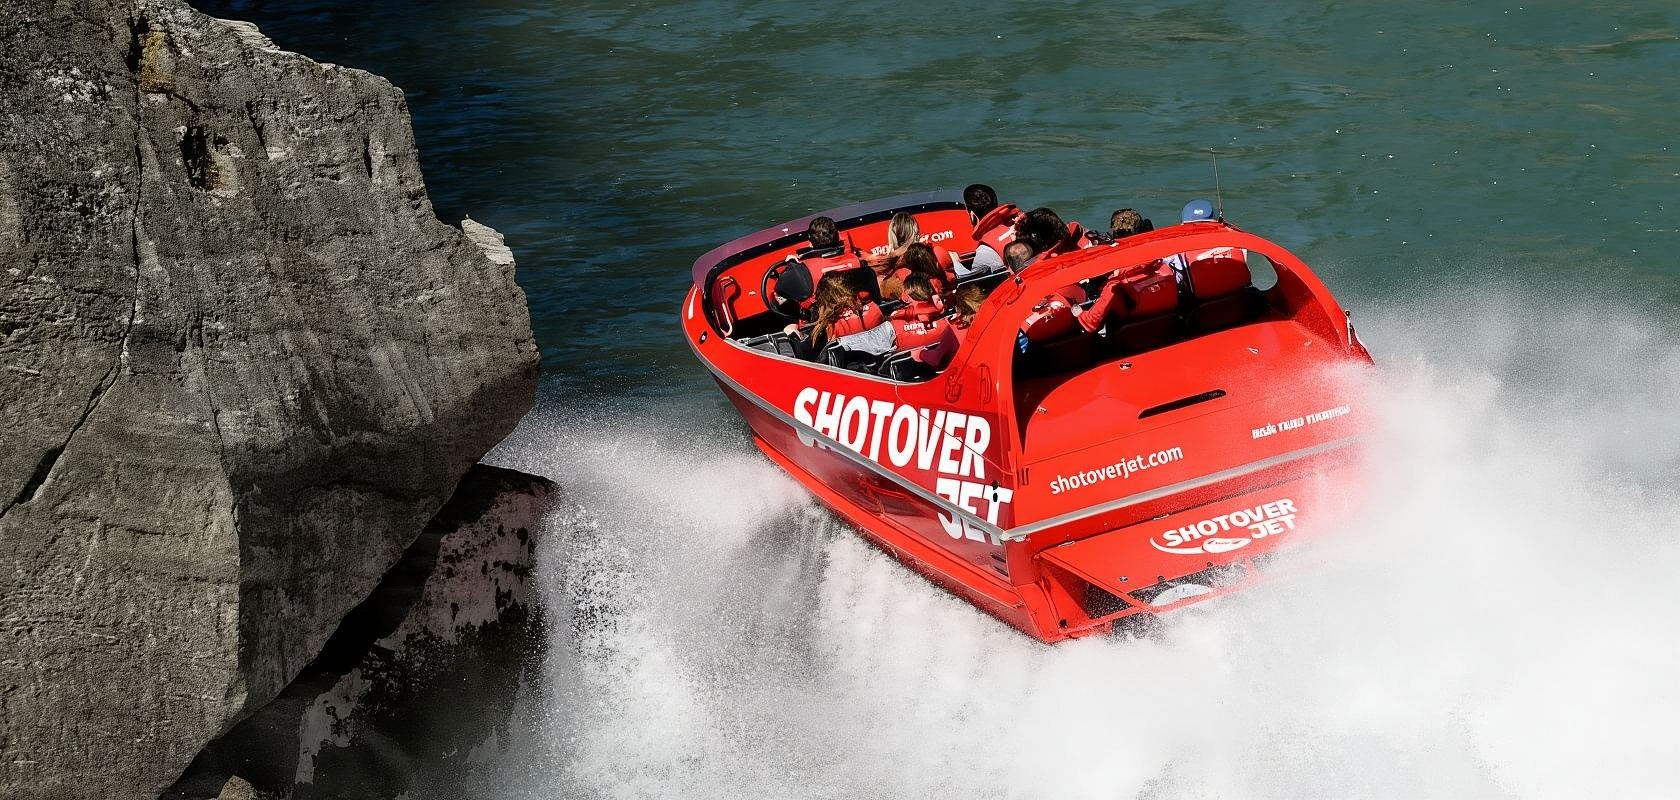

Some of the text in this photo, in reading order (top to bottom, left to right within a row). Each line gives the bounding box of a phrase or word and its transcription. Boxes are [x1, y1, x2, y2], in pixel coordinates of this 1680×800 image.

[793, 387, 991, 480] SHOTOVER
[1049, 446, 1184, 495] shotoverjet.com
[936, 477, 1014, 546] JET
[1162, 498, 1298, 547] SHOTOVER
[1247, 513, 1297, 539] JET
